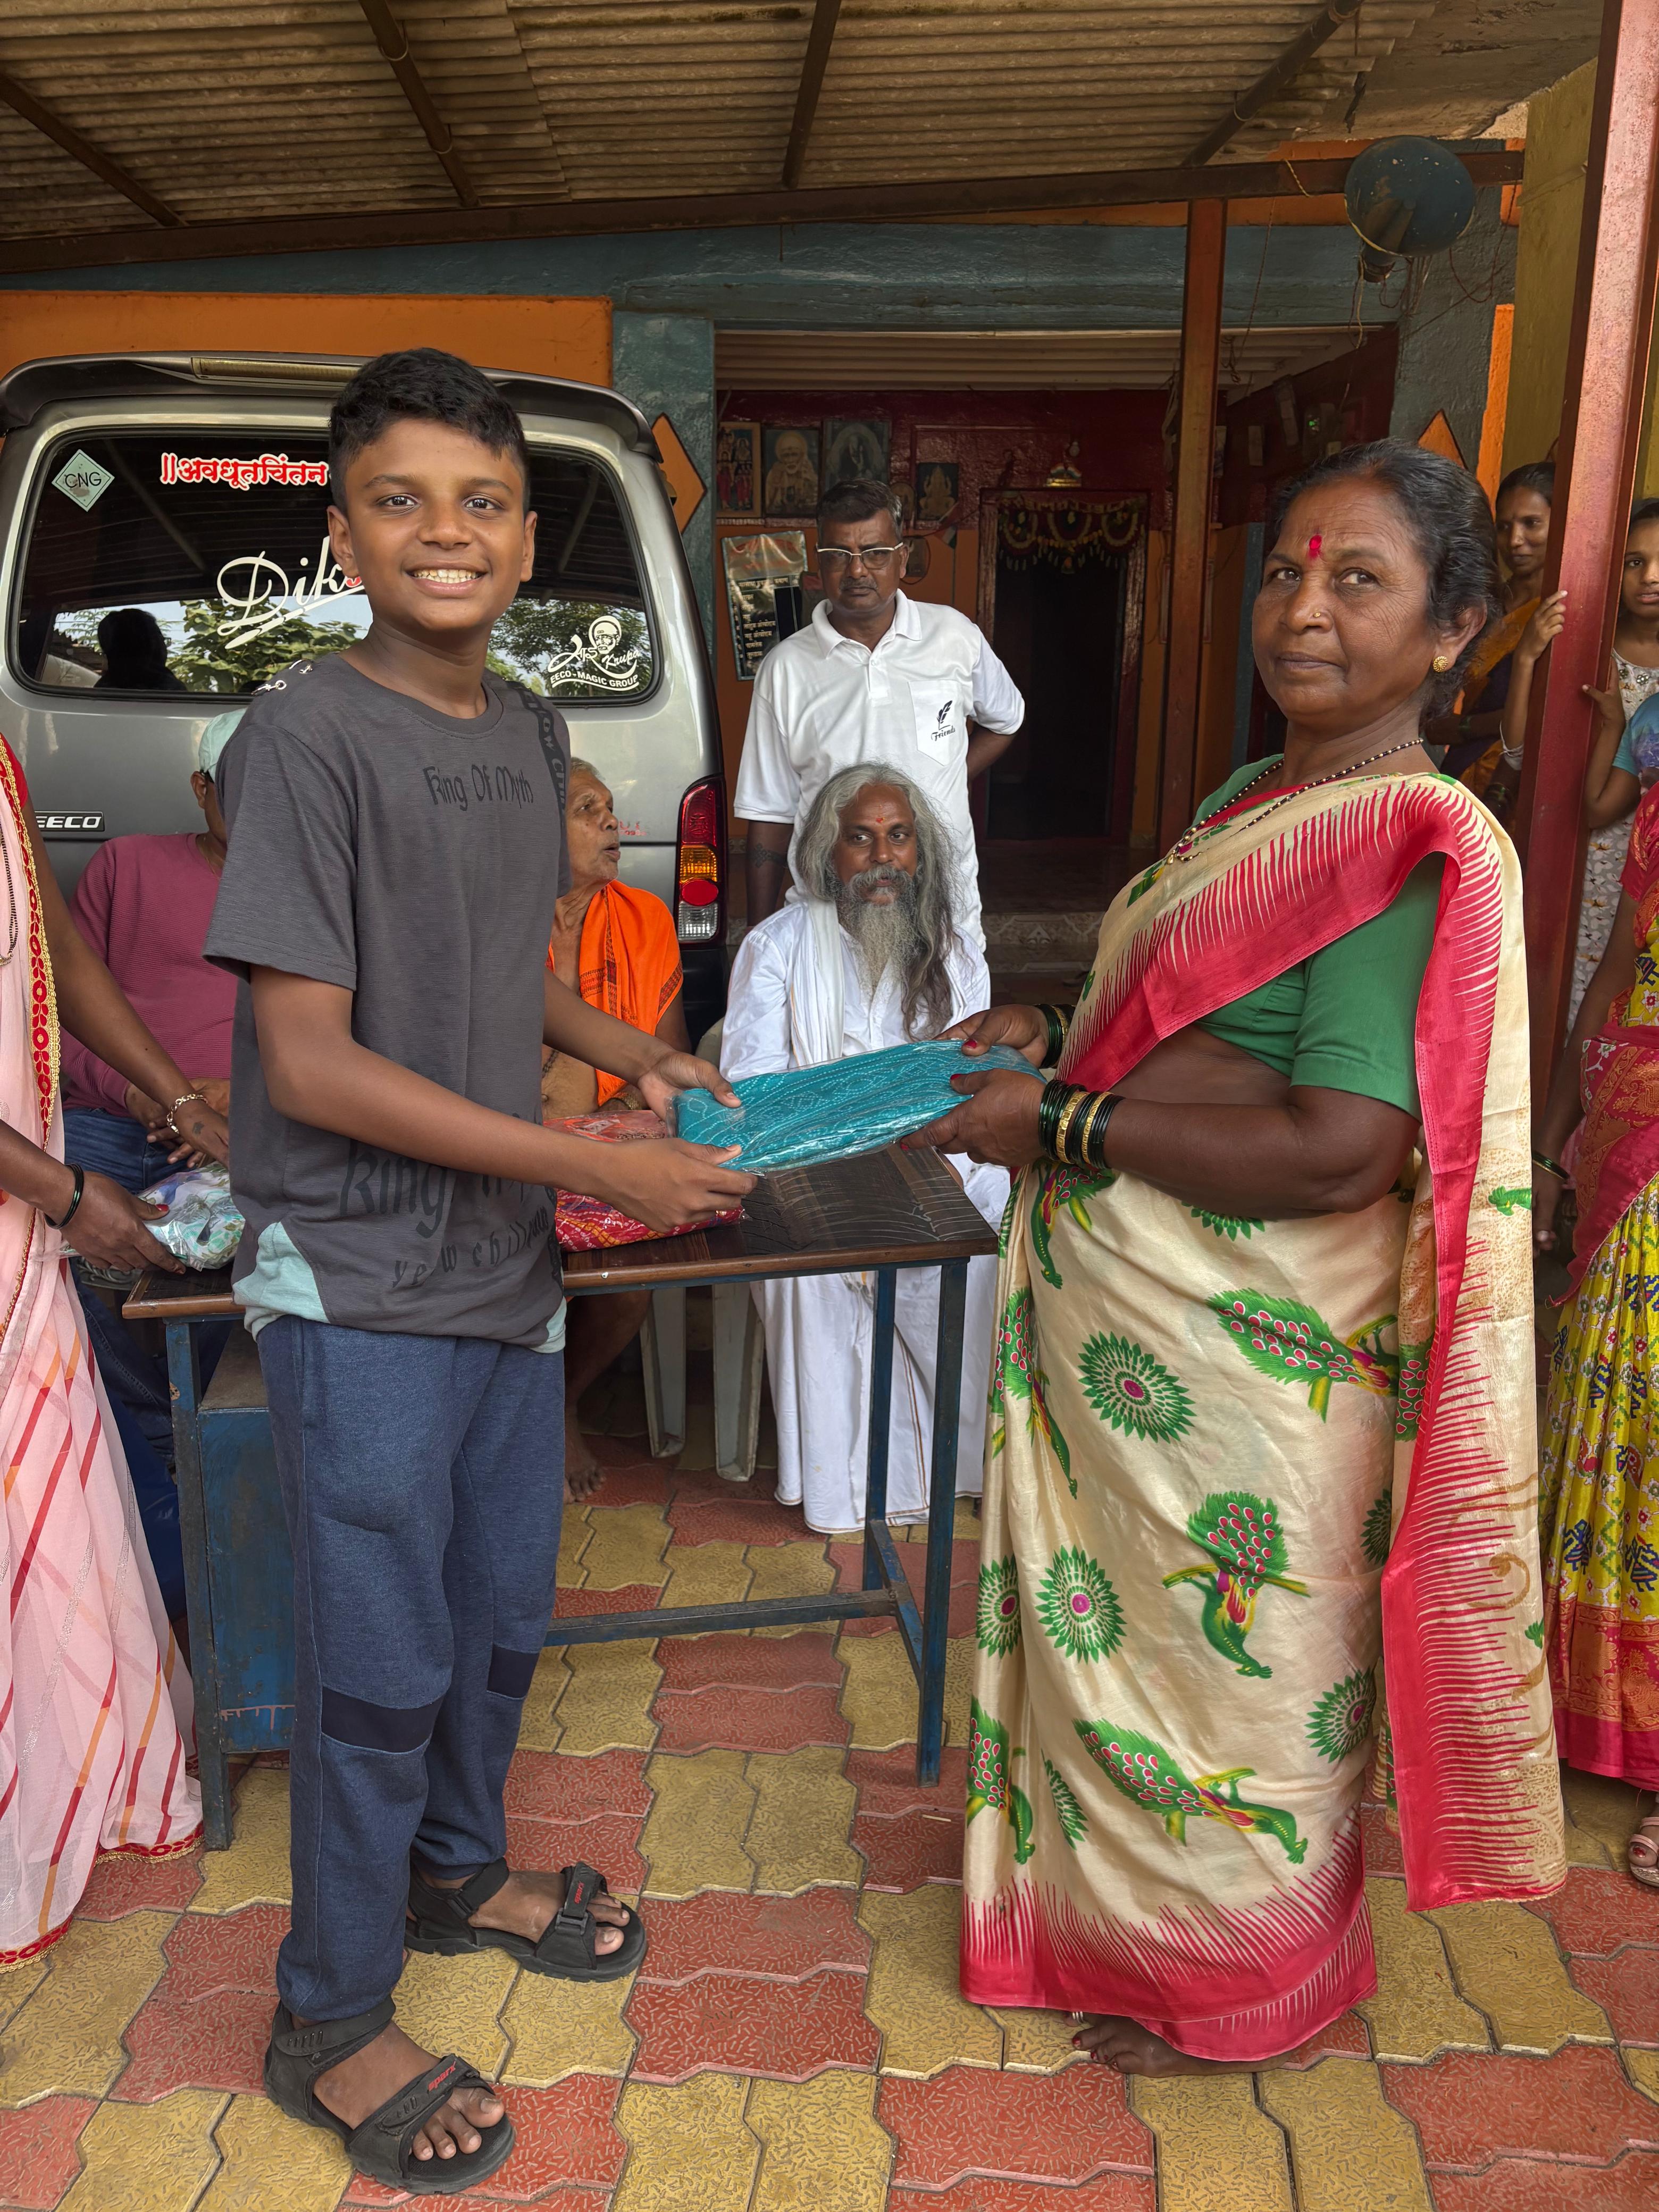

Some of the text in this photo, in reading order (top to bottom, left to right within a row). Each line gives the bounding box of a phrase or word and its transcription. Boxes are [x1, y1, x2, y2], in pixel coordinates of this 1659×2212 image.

[65, 472, 102, 488] CNG
[601, 650, 640, 669] Krupa
[609, 674, 639, 688] GROUP
[931, 725, 956, 741] Friends
